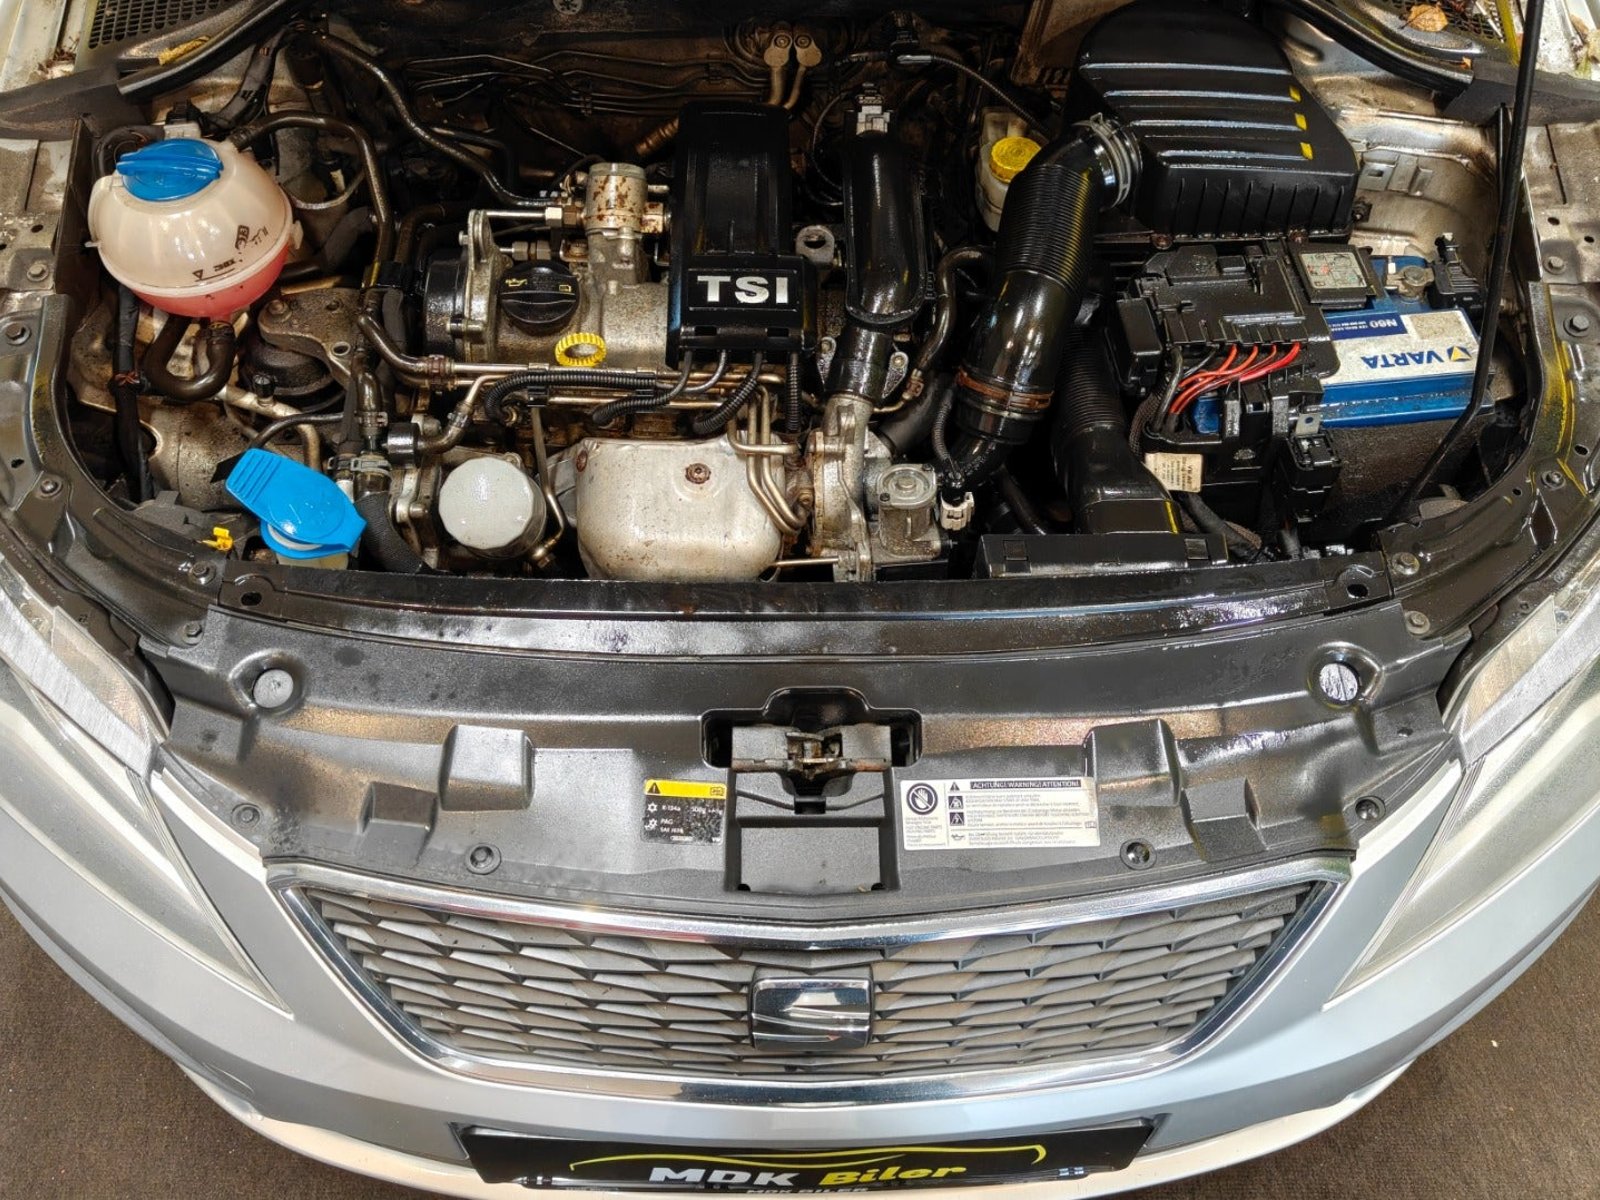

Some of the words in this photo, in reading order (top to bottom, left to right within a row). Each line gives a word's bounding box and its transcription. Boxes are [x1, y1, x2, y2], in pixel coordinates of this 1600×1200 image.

[697, 275, 788, 304] TSI
[1369, 318, 1398, 329] N60
[1360, 350, 1444, 370] VARTA
[972, 781, 1007, 789] ACHTUNG!
[1008, 780, 1041, 788] WARNING!
[1042, 779, 1080, 787] ATTENTION!
[649, 1167, 798, 1186] MDK
[819, 1166, 967, 1185] Biler
